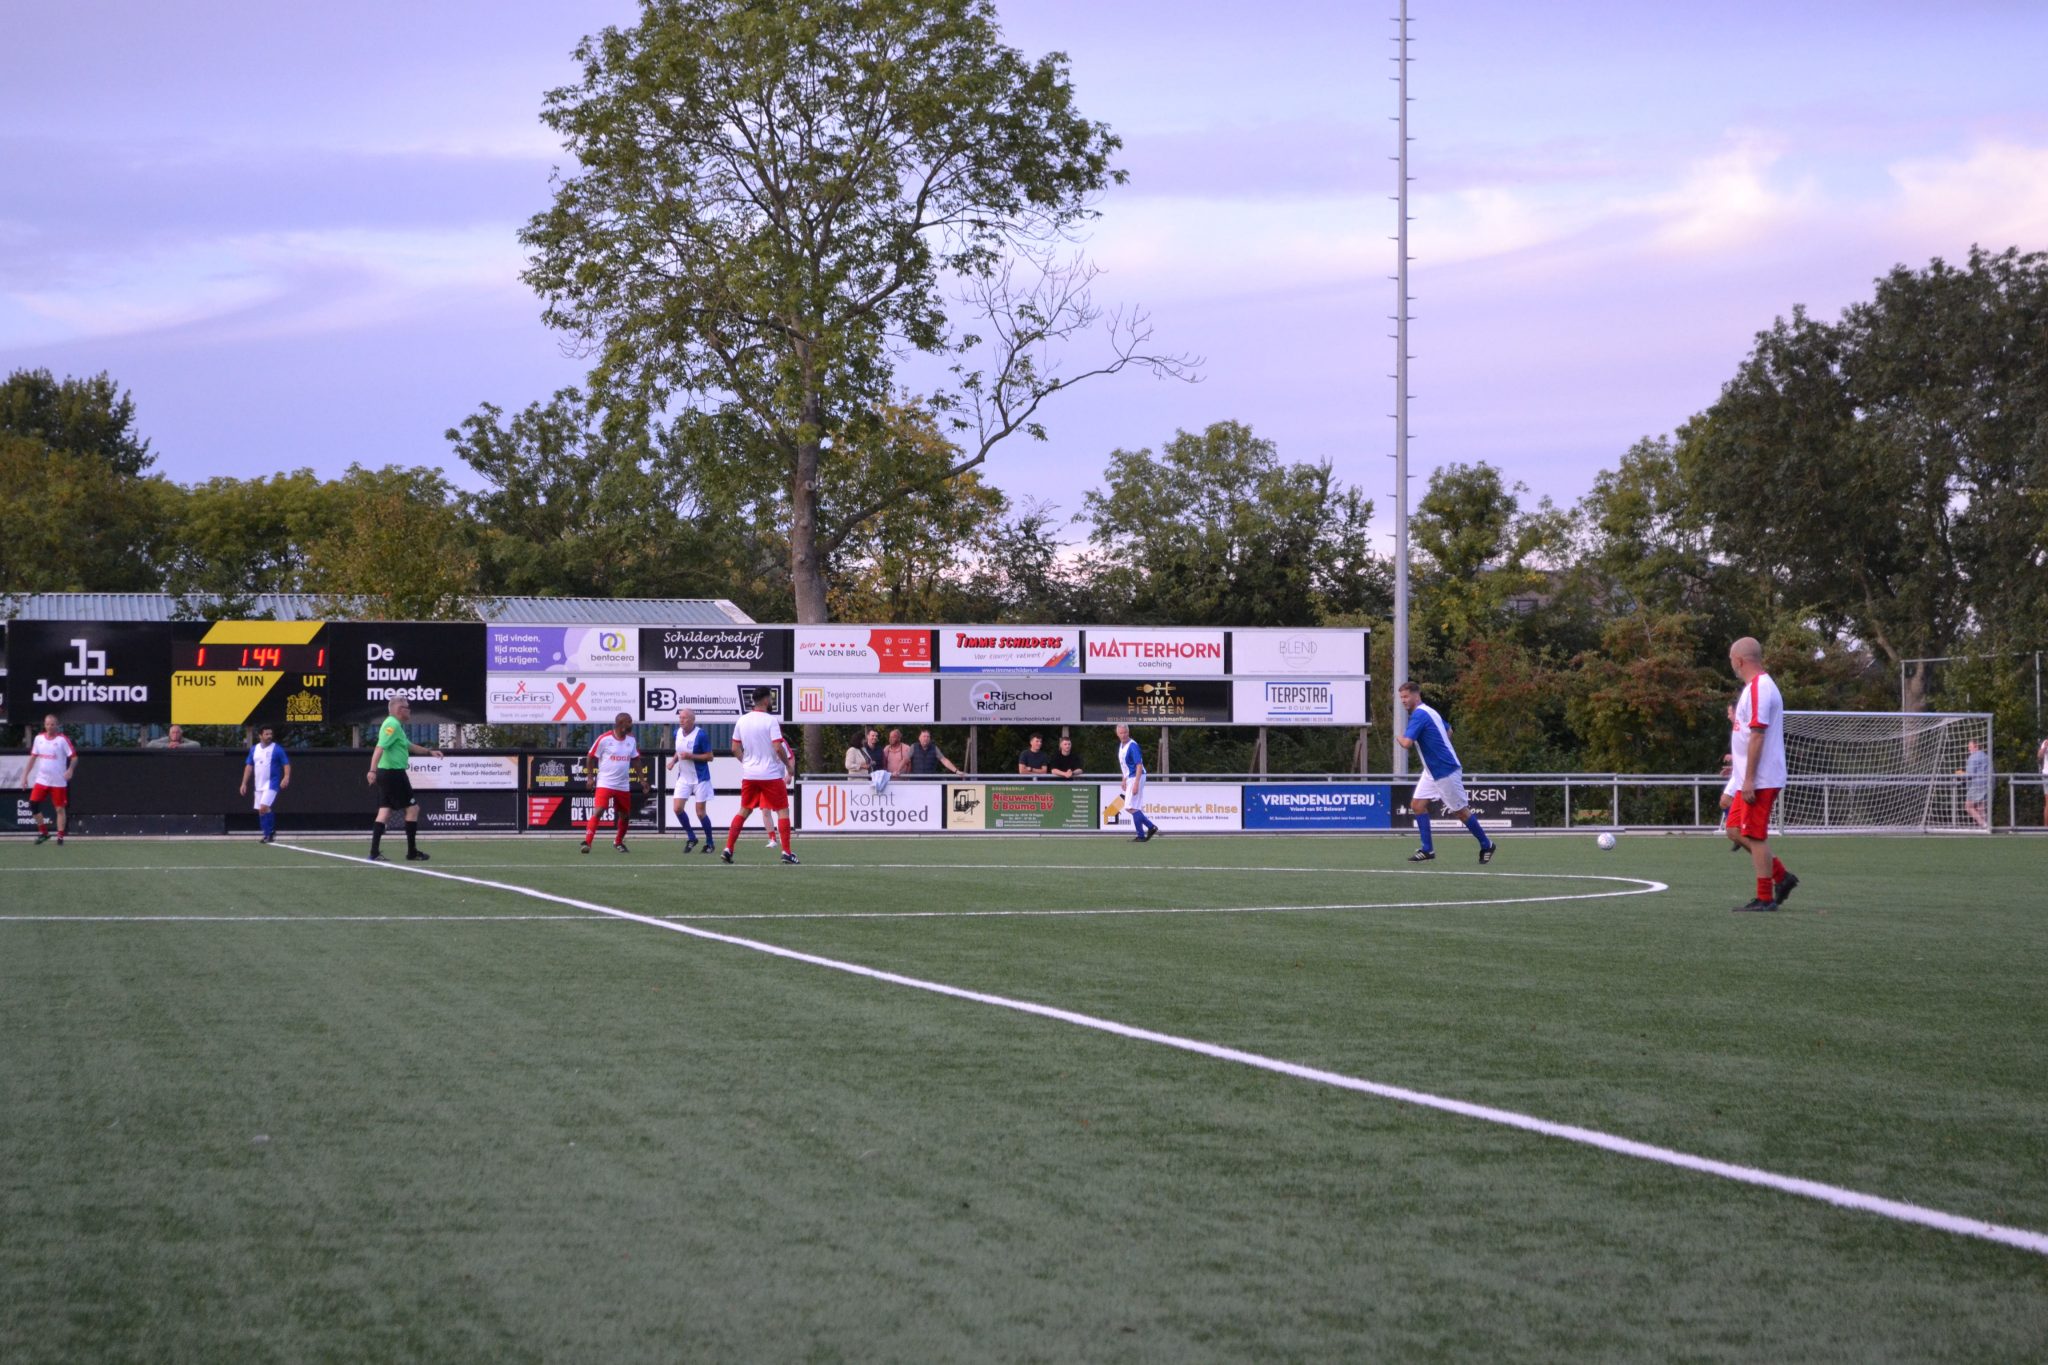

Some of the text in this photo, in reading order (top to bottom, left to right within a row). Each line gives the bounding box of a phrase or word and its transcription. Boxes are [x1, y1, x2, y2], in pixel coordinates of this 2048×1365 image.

[494, 634, 508, 643] Tijd
[663, 631, 764, 647] Schildersbedrijf
[956, 633, 1063, 649] TIMME SCHILDERS
[367, 643, 395, 661] De
[494, 645, 508, 654] tijd
[1089, 637, 1221, 658] MATTERHORN
[1279, 641, 1318, 654] BLEND
[494, 655, 508, 664] tijd
[590, 654, 635, 662] bentacera
[1138, 661, 1172, 669] coaching
[174, 675, 217, 687] THUIS
[236, 675, 265, 687] MIN
[302, 675, 327, 687] UIT
[33, 679, 148, 702] Jorritsma
[827, 691, 887, 699] Tegelgroothandel
[1270, 687, 1328, 703] TERPSTRA
[493, 694, 551, 702] FlexFirst
[678, 695, 737, 704] aluminiumbouw
[990, 692, 1053, 702] Rijschool
[1127, 696, 1185, 705] LOHMAN
[827, 703, 930, 713] Julius van der Werf
[977, 701, 1016, 711] Richard
[1127, 705, 1185, 715] FIETSEN
[850, 789, 896, 807] komt
[992, 793, 1054, 803] Nieuwenhuis
[1261, 794, 1375, 806] VRIENDENLOTERIJ
[1466, 789, 1507, 801] IKSEN
[17, 800, 29, 808] De
[1040, 802, 1054, 810] BV
[1205, 803, 1238, 813] Rinse
[427, 813, 477, 821] VANDILLEN
[571, 808, 585, 820] DE
[850, 805, 928, 826] vastgoed
